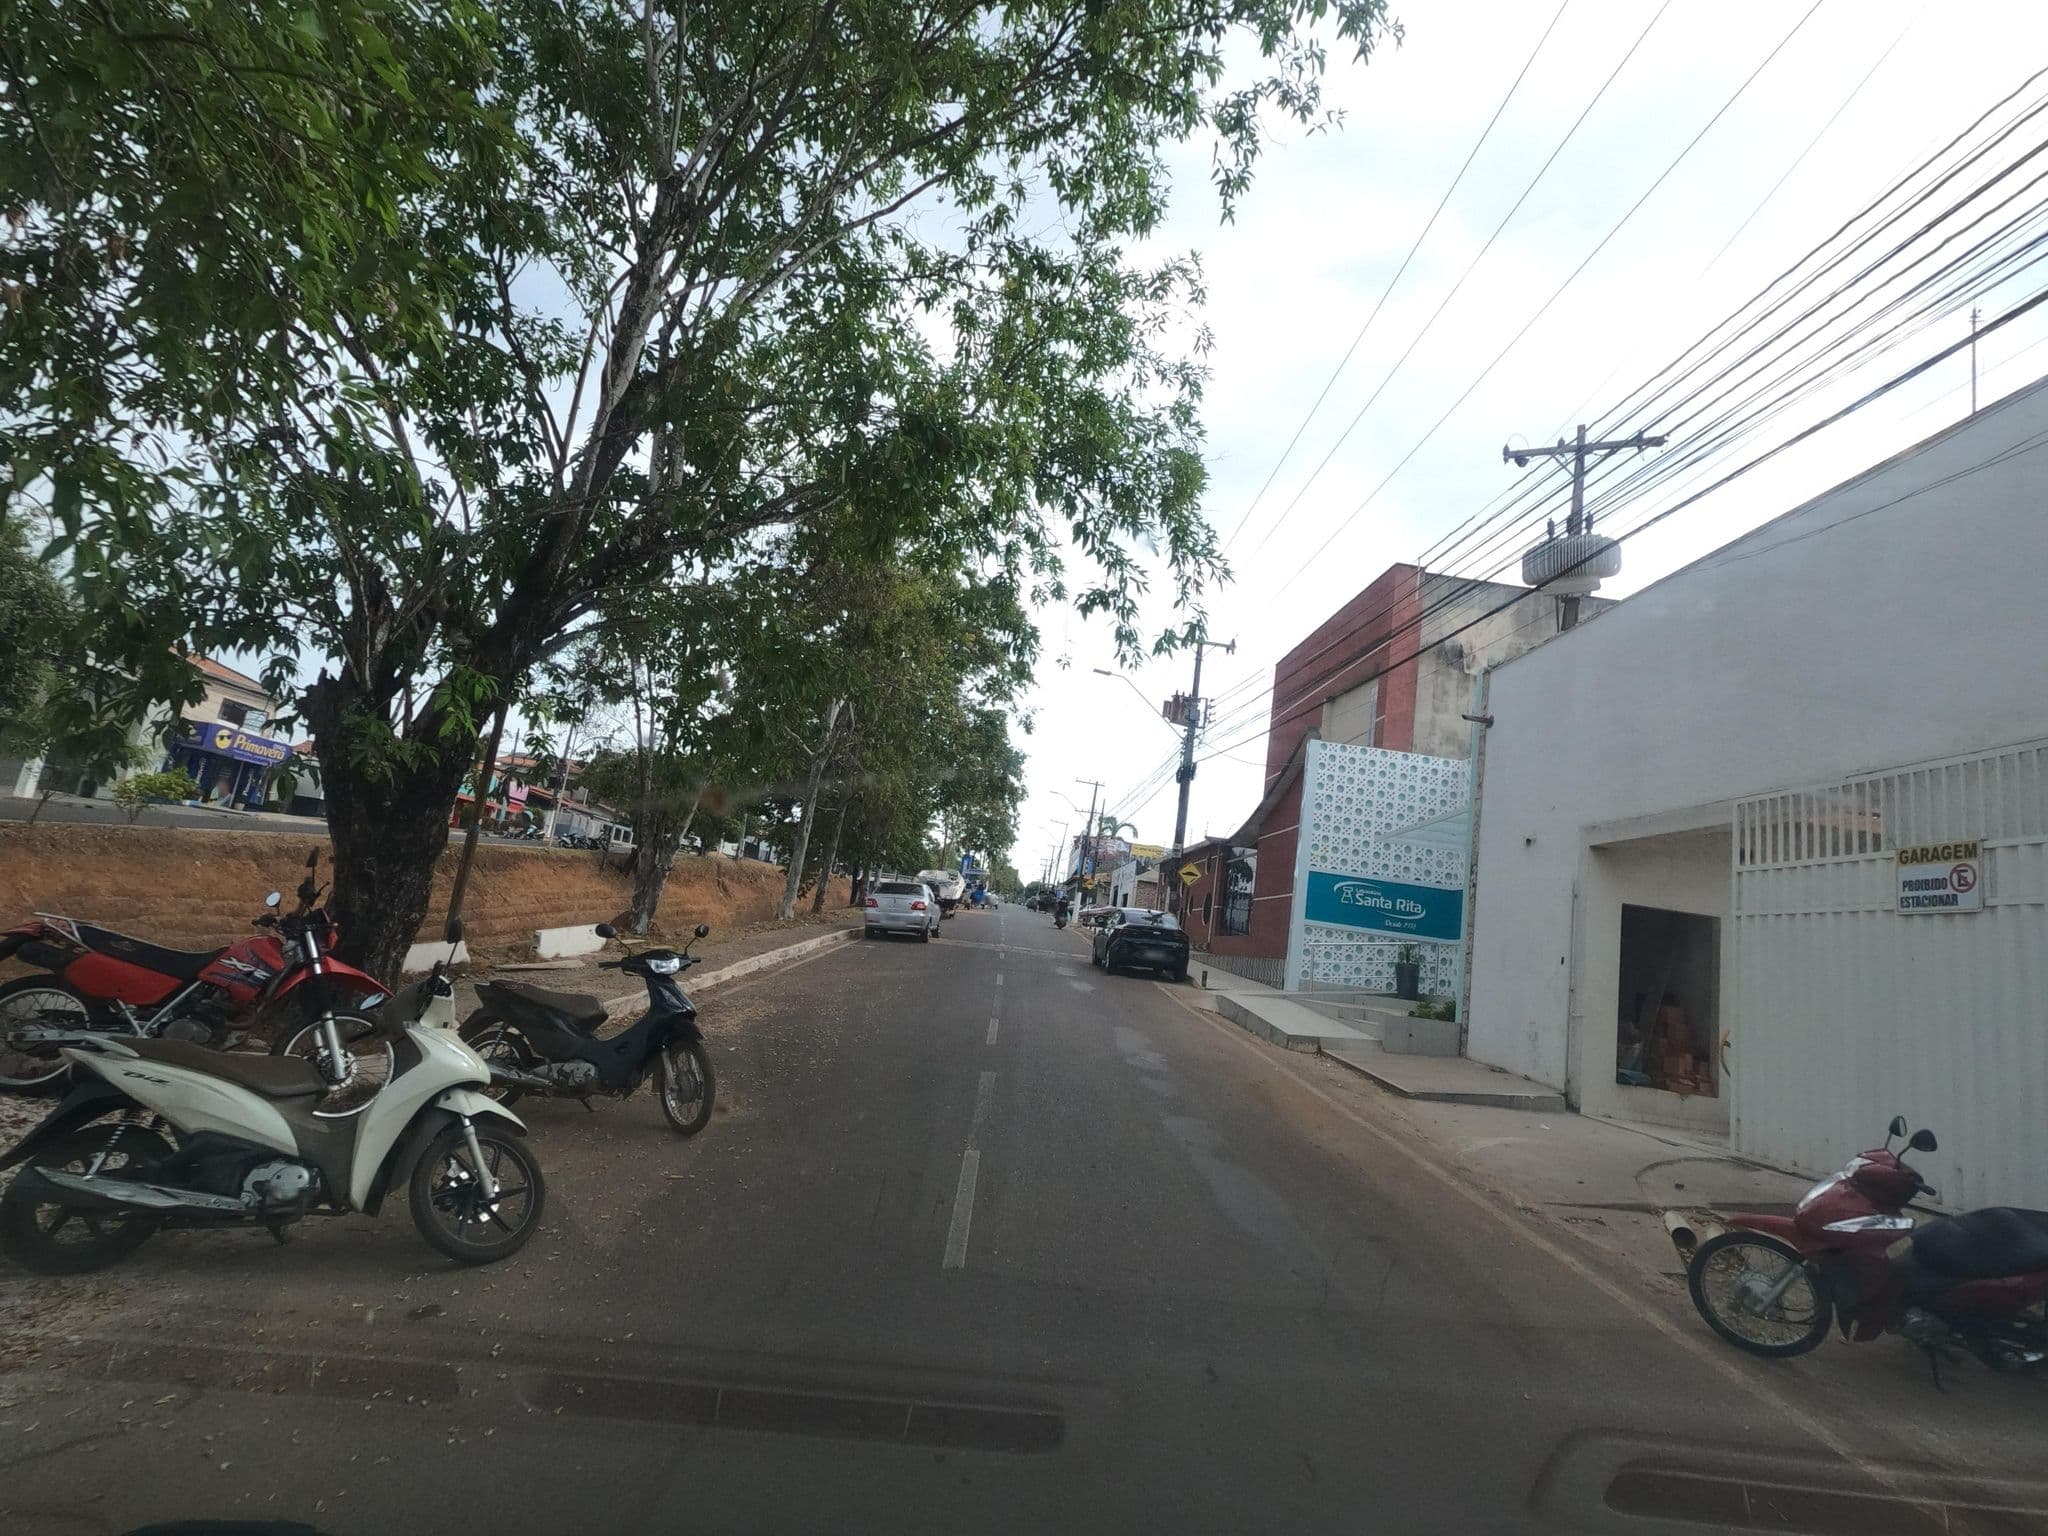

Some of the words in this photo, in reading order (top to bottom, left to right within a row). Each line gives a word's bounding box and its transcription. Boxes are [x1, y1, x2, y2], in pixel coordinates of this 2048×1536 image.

[233, 734, 285, 760] Primavera
[1900, 843, 1978, 865] GARAGEM
[1902, 877, 1948, 892] PROIBIDO
[1355, 893, 1392, 910] Santa
[1396, 898, 1422, 914] Rita
[1900, 893, 1959, 909] ESTACIONAR
